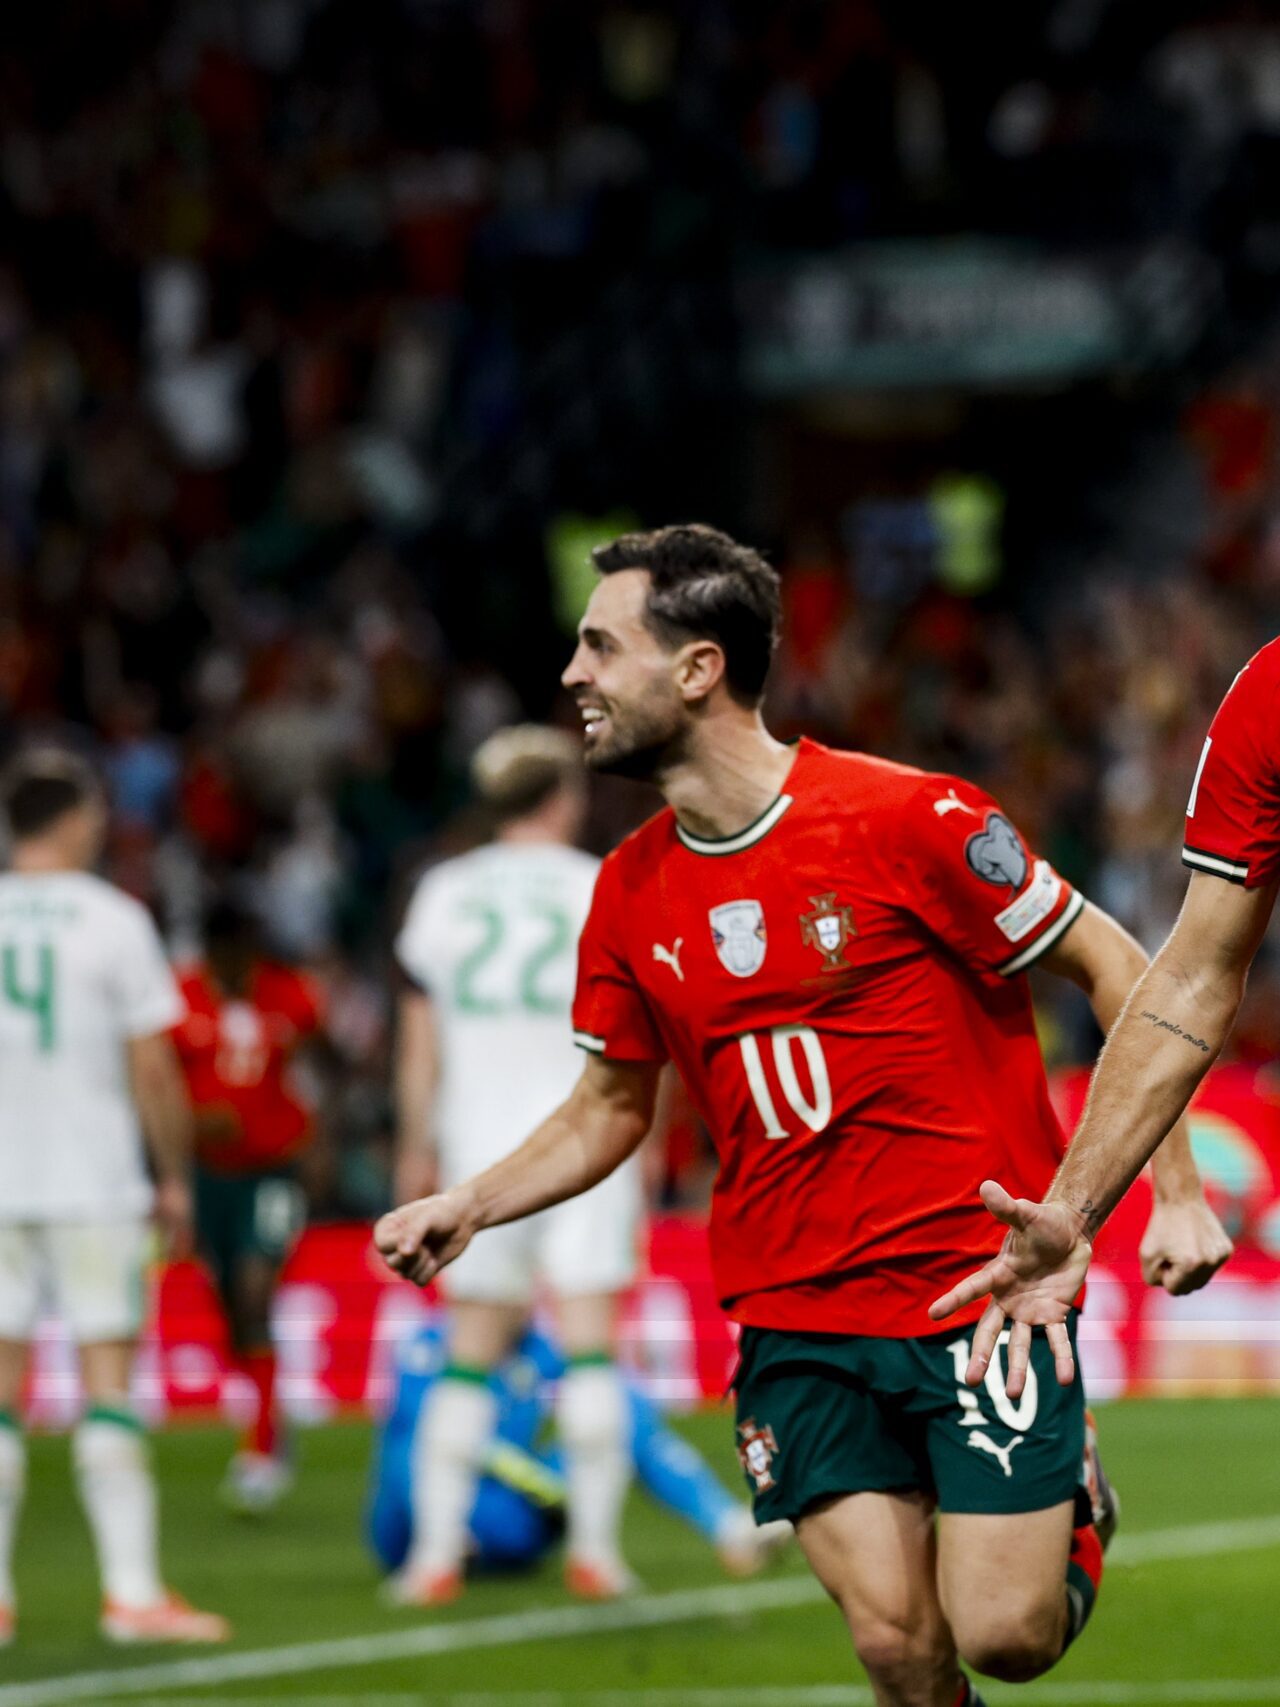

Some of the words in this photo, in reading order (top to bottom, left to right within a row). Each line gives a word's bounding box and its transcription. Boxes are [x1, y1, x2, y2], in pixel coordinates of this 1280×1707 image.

[1, 936, 57, 1057] 4
[451, 895, 573, 1016] 22
[739, 1022, 832, 1140] 10
[1154, 1020, 1183, 1035] pelo
[946, 1329, 1040, 1433] 10
